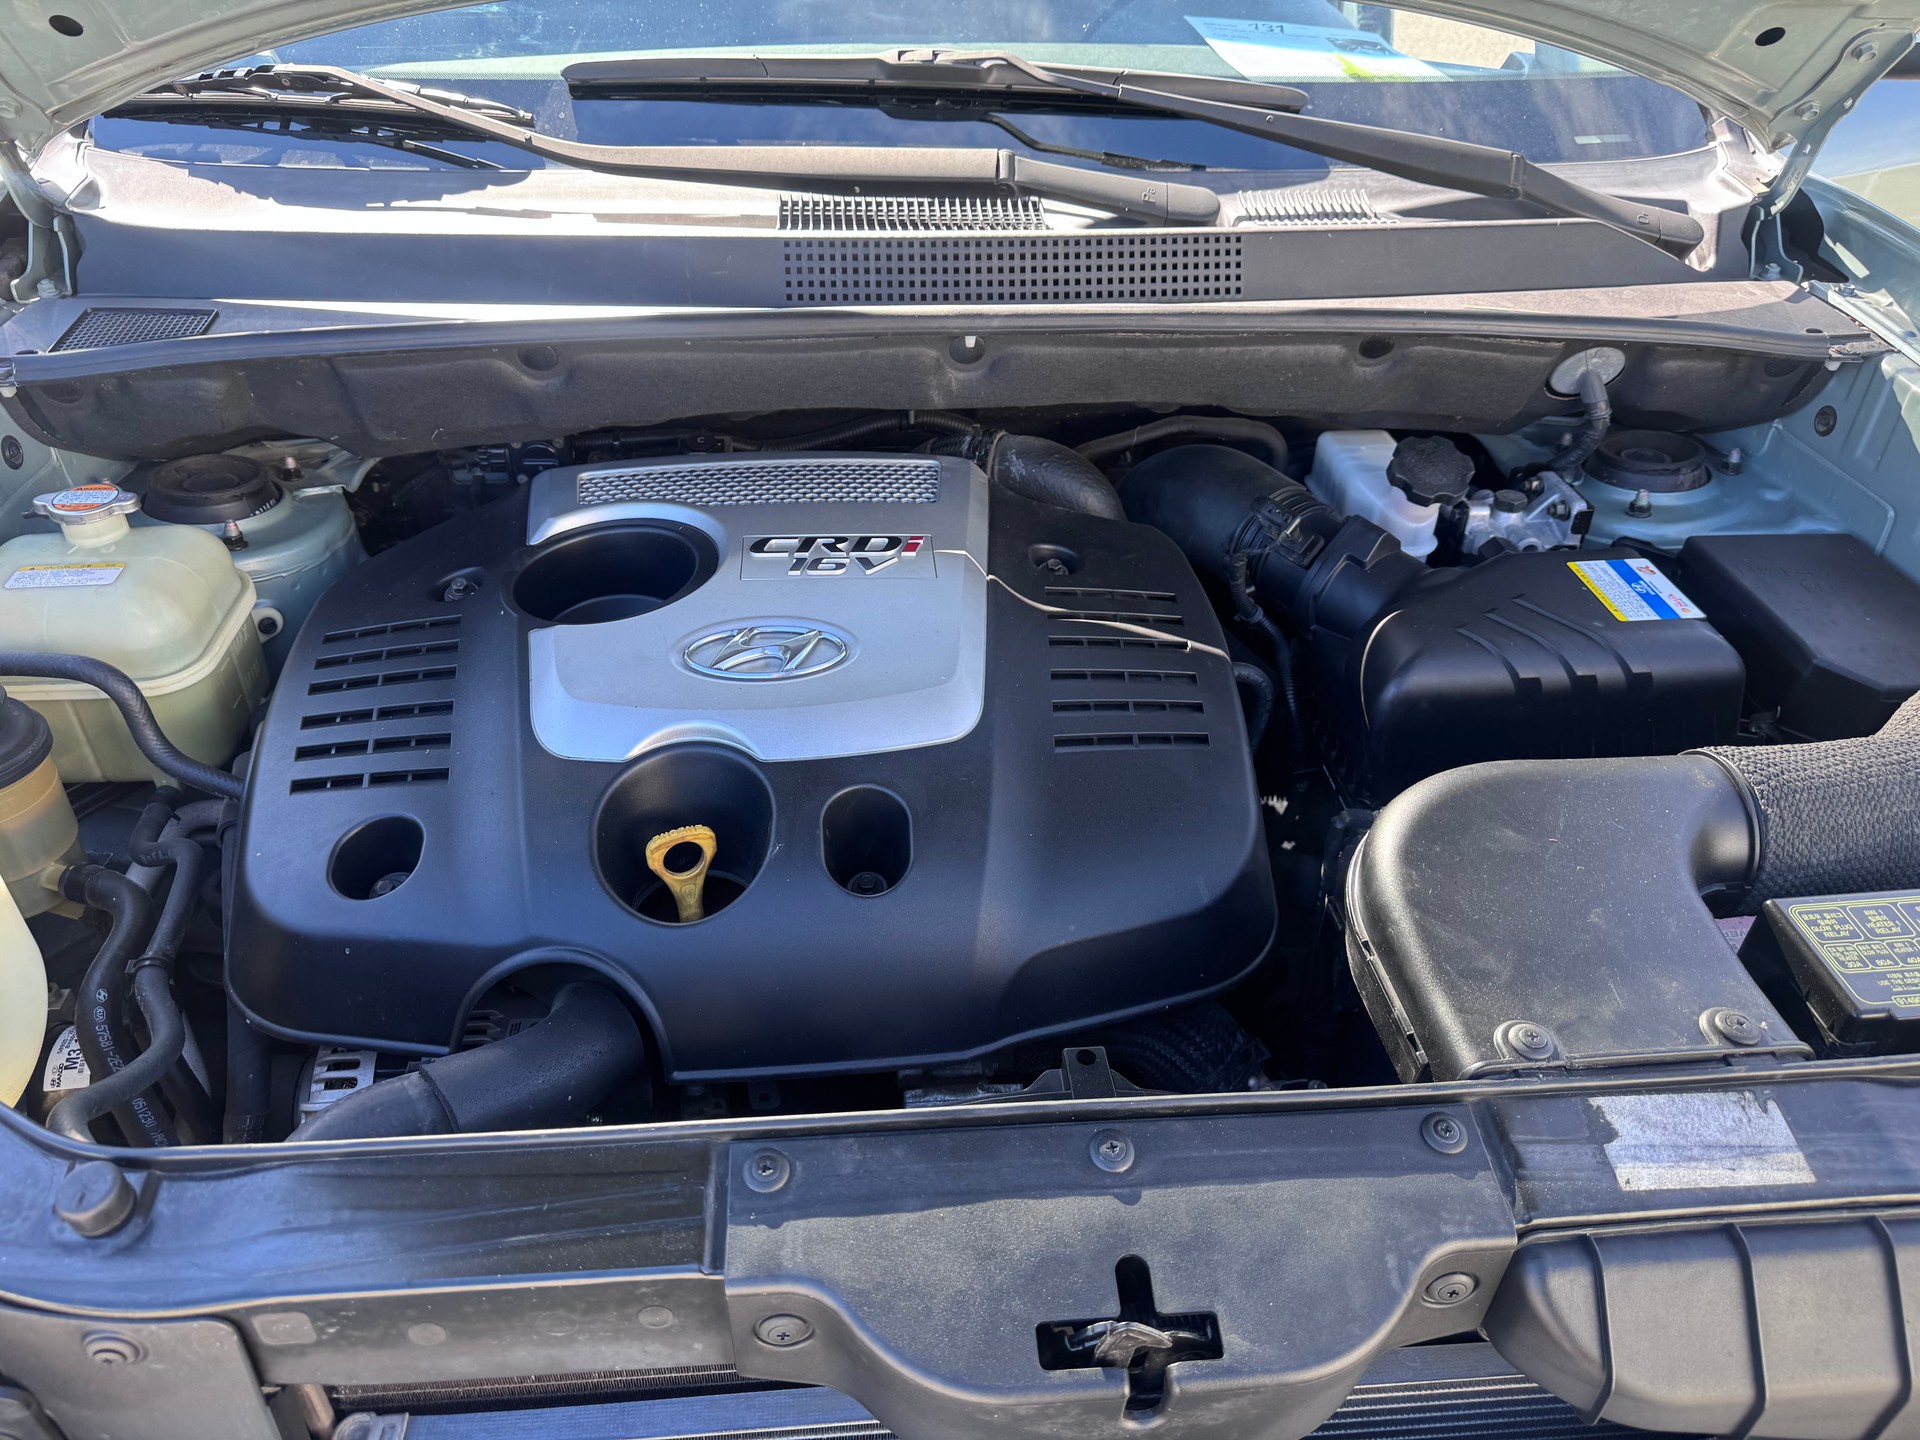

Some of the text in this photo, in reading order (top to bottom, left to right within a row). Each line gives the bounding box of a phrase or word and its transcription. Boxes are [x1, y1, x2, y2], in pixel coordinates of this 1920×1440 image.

[749, 536, 924, 557] CRDi
[1865, 921, 1895, 929] HEATER
[56, 1063, 64, 1087] MANDO
